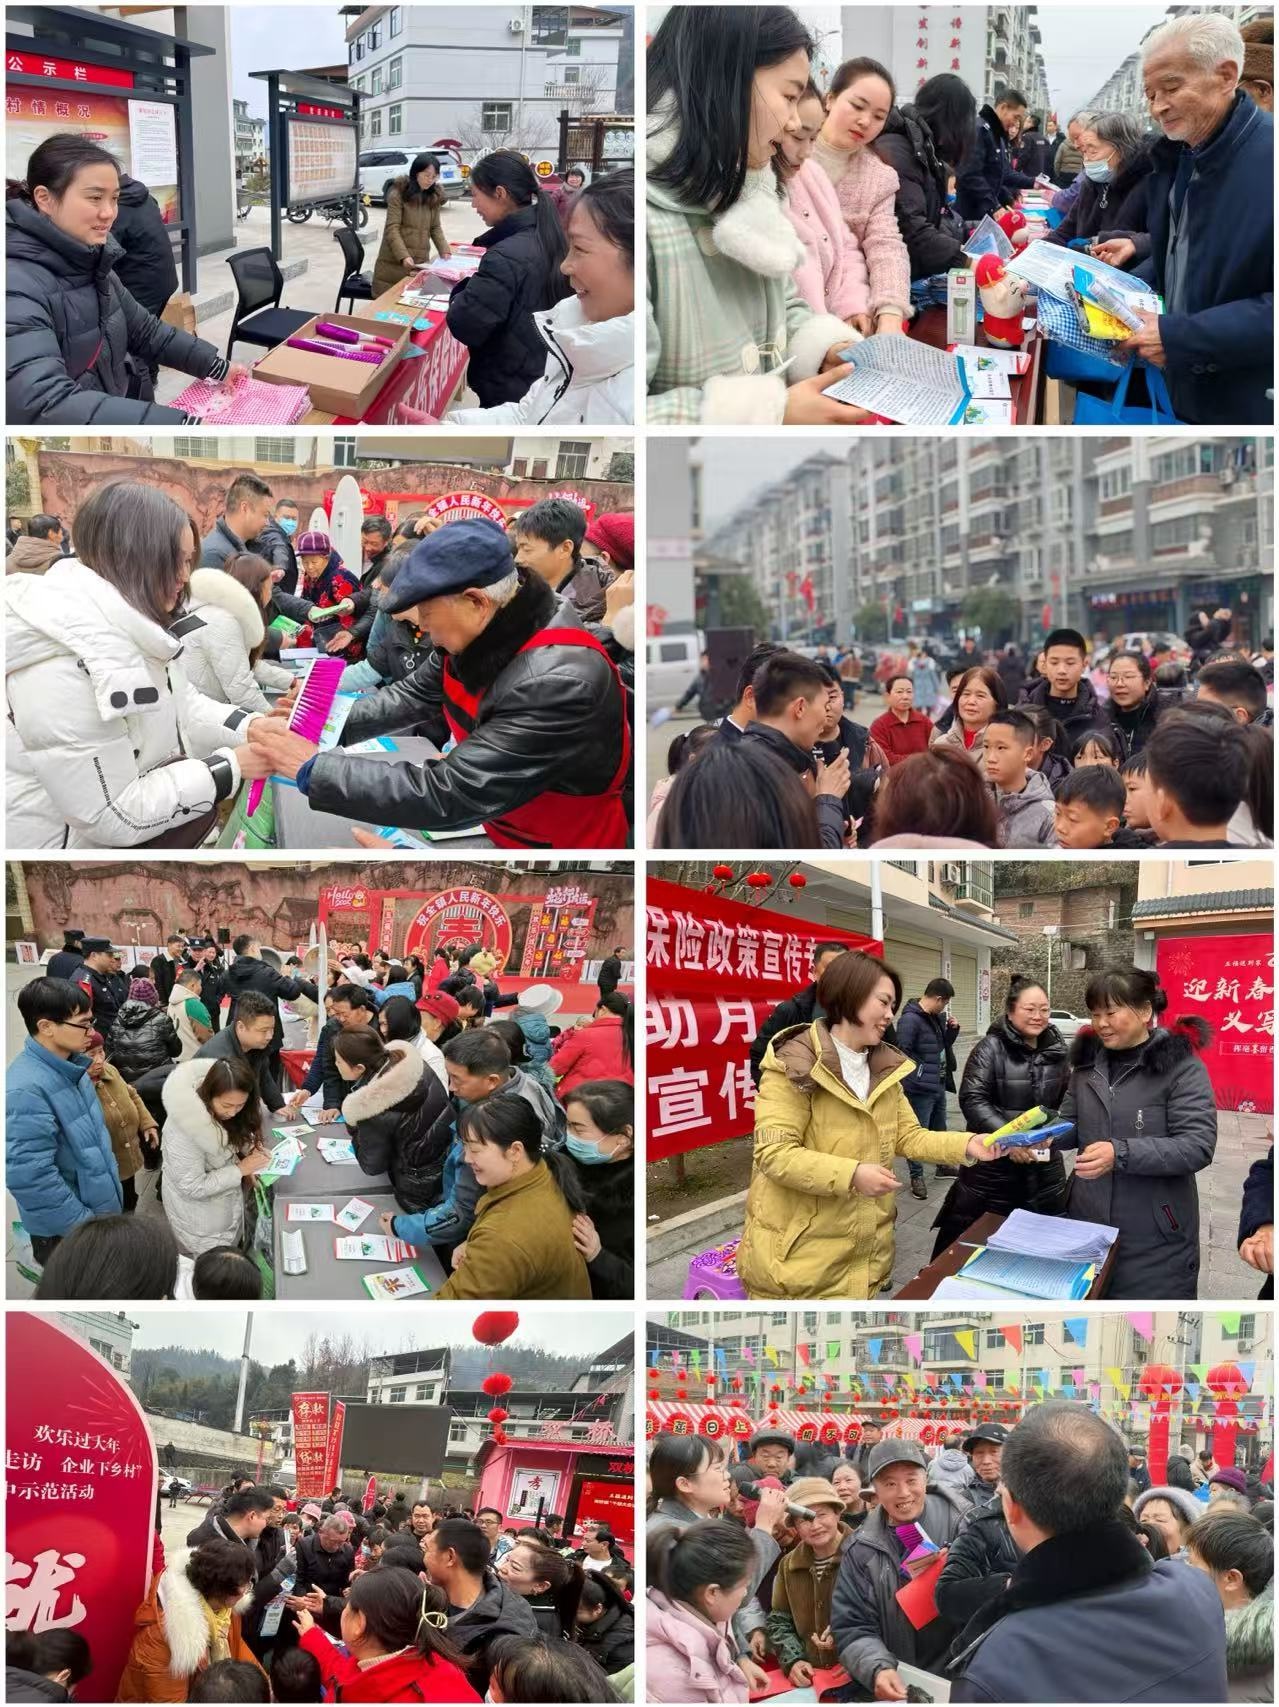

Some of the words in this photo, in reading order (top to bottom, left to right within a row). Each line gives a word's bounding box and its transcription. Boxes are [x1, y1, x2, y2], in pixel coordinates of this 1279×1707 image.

[8, 56, 88, 81] 公示栏
[7, 98, 91, 118] 村情概况
[1183, 975, 1274, 1004] 迎新春
[646, 993, 784, 1050] 助月
[33, 1424, 120, 1454] 欢乐过大年
